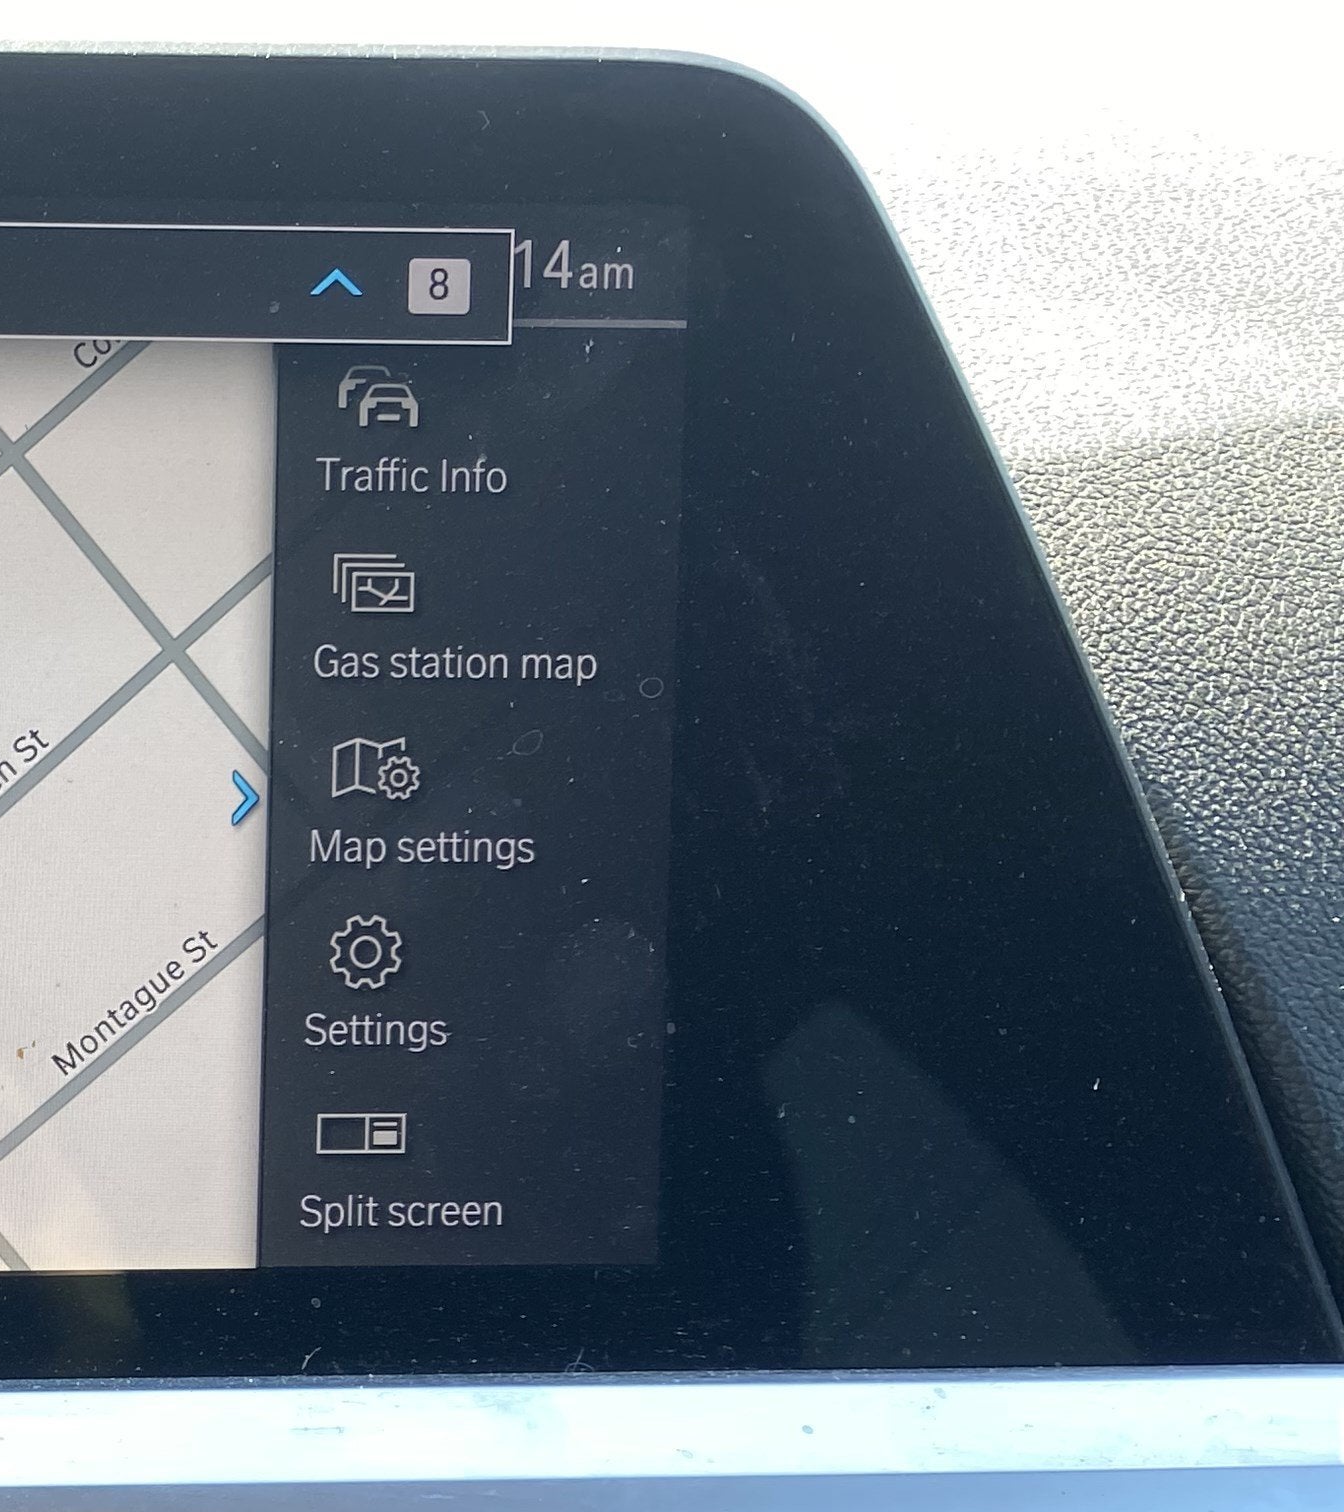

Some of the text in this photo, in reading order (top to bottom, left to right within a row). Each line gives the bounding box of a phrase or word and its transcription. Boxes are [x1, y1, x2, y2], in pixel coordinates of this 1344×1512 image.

[429, 267, 449, 301] 8
[315, 456, 507, 493] Traffic Info
[313, 644, 597, 688] Gas station map
[12, 729, 49, 763] St
[310, 829, 535, 870] Map settings
[51, 930, 218, 1076] Montague St
[304, 1012, 447, 1052] Settings
[300, 1194, 502, 1234] Split screen
